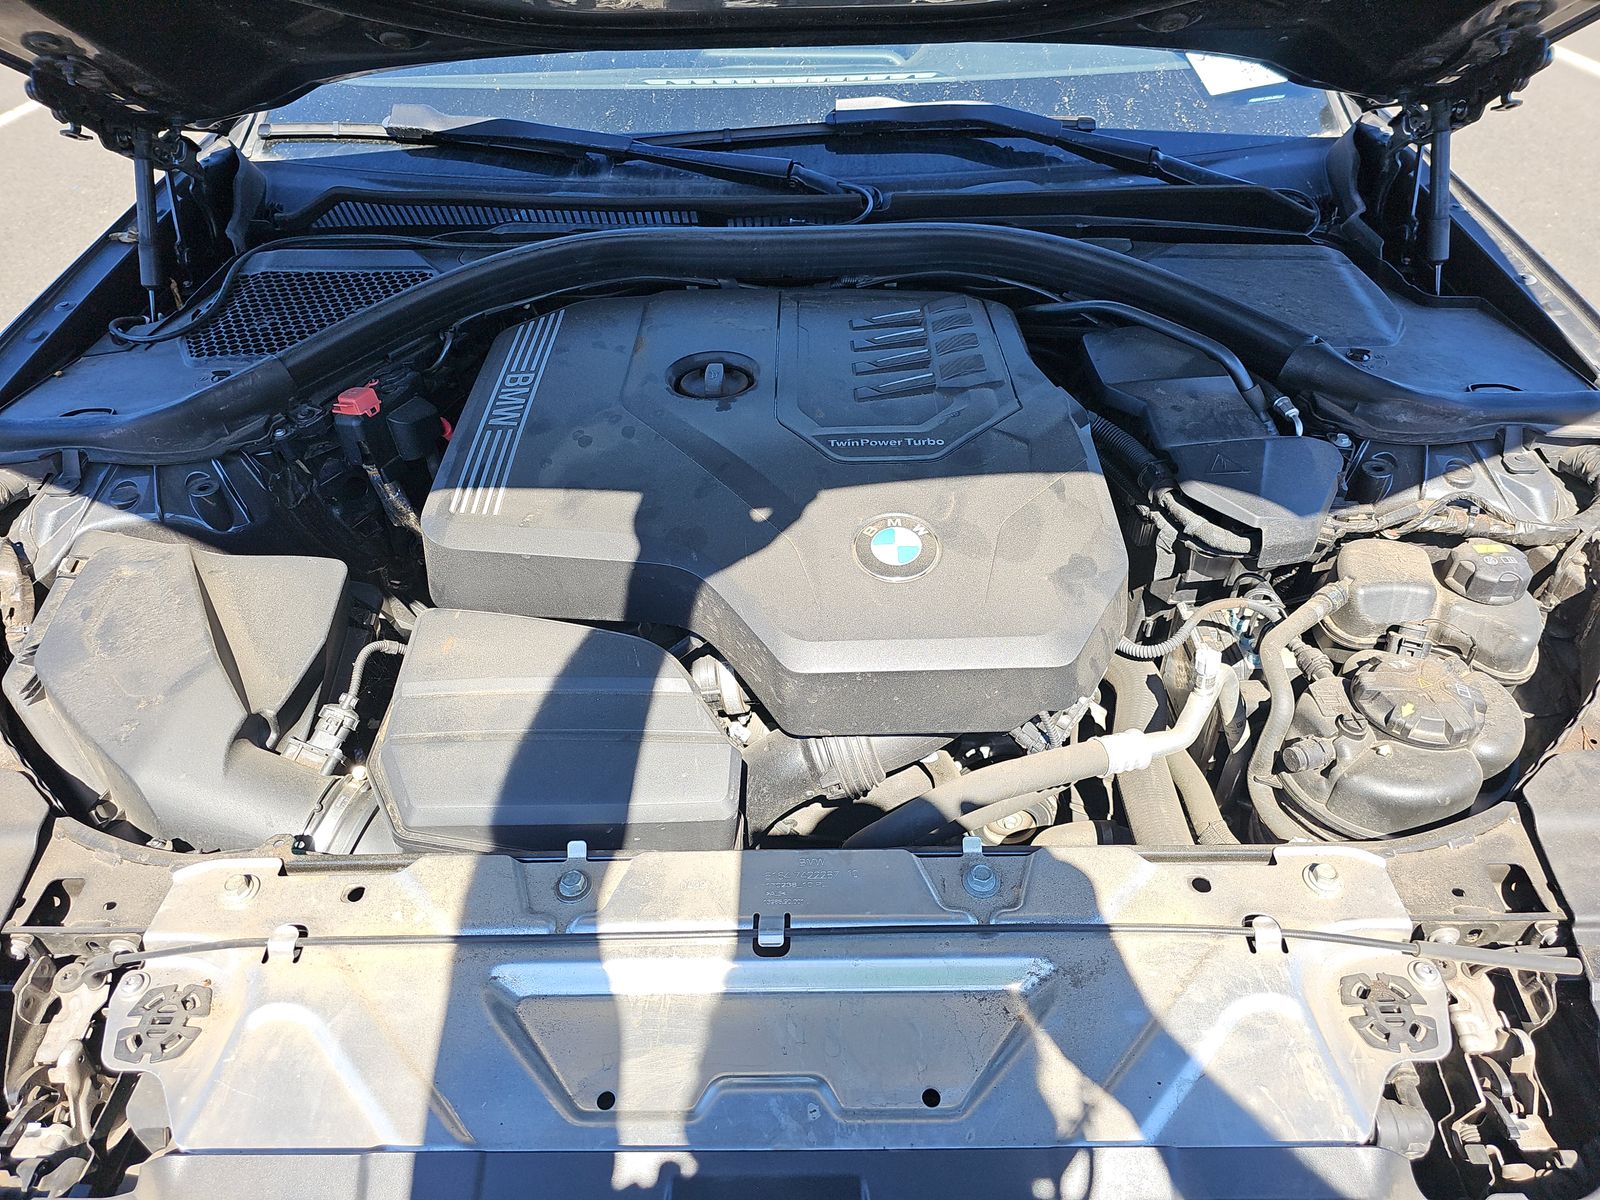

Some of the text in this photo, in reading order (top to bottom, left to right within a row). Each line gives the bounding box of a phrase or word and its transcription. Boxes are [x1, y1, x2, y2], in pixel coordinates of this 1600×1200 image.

[488, 373, 535, 426] BMW
[829, 437, 945, 447] TwinPower Turbo
[862, 518, 929, 537] BMW
[799, 857, 825, 867] BMW
